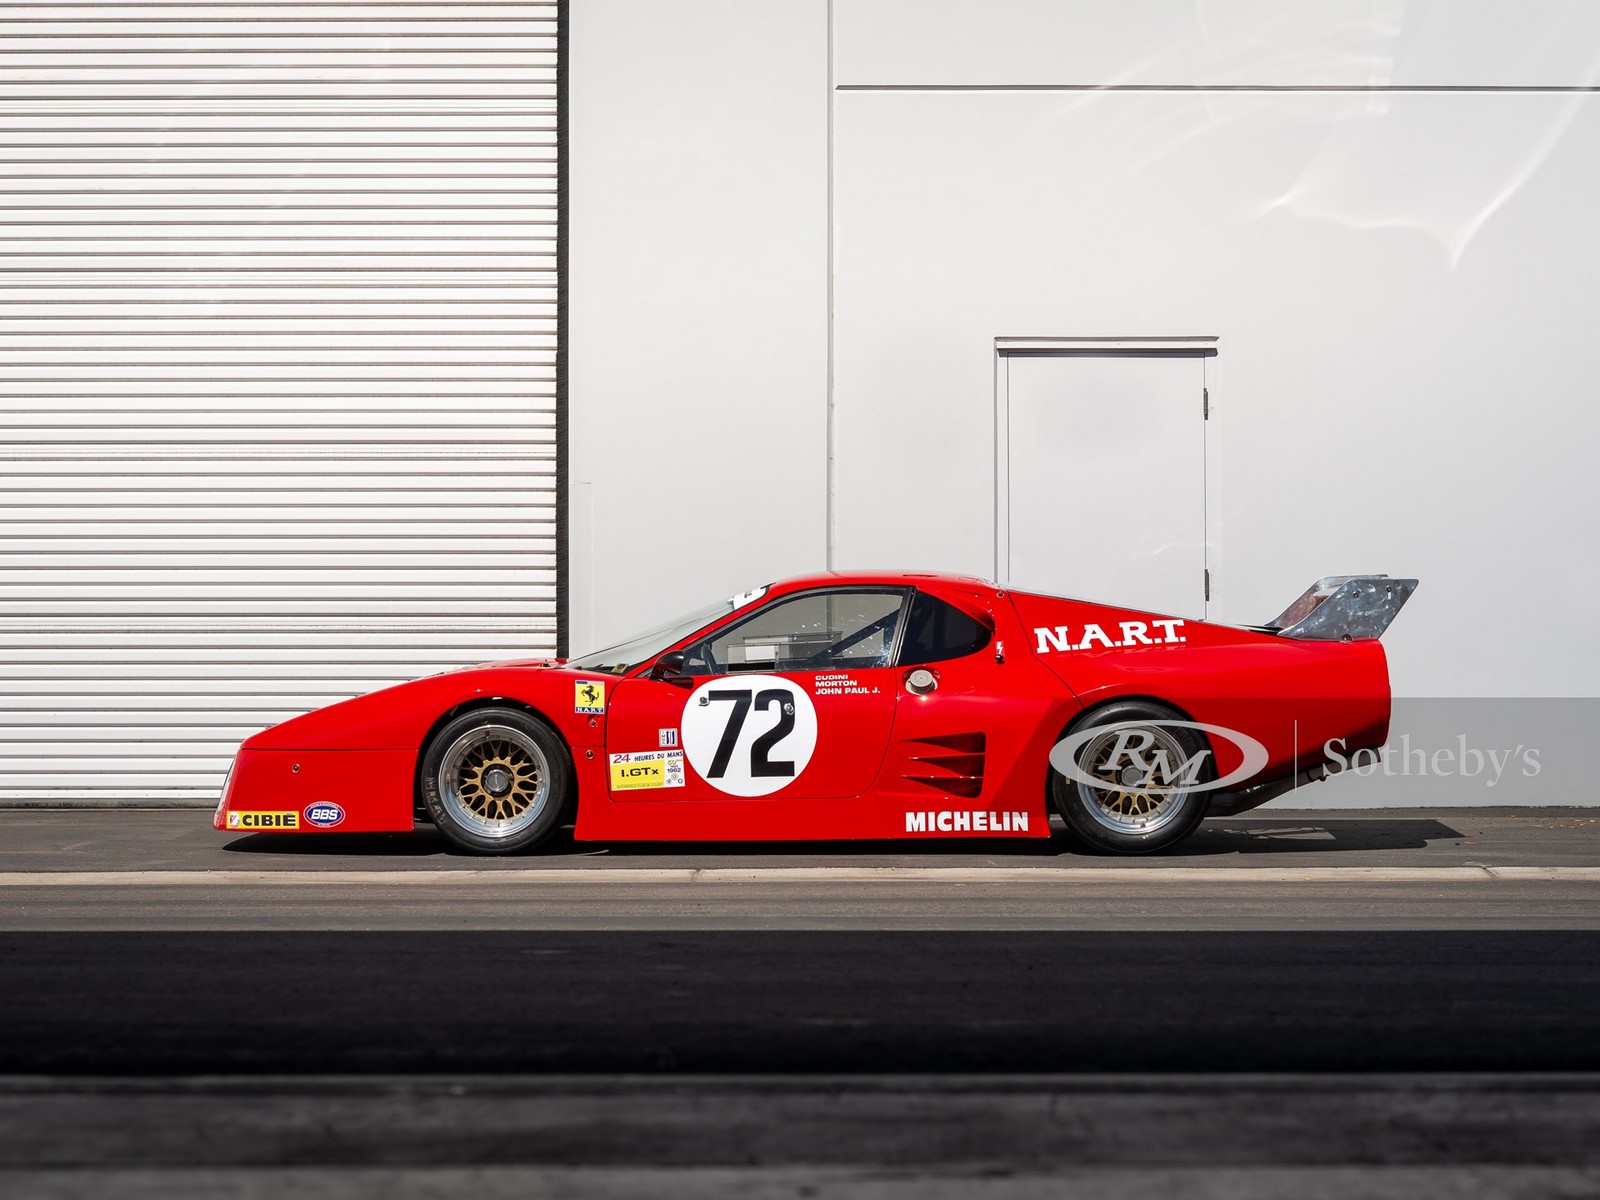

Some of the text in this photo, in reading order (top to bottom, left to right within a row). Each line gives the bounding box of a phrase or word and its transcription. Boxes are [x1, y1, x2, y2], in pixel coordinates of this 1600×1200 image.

[1033, 619, 1187, 654] N.A.R.T.
[815, 687, 842, 695] JOHN
[871, 686, 881, 694] J.
[707, 689, 795, 778] 72
[613, 754, 631, 764] 24
[634, 754, 655, 762] HEURES
[667, 751, 683, 759] MANS
[311, 809, 339, 820] BBS
[905, 811, 1029, 832] MICHELIN
